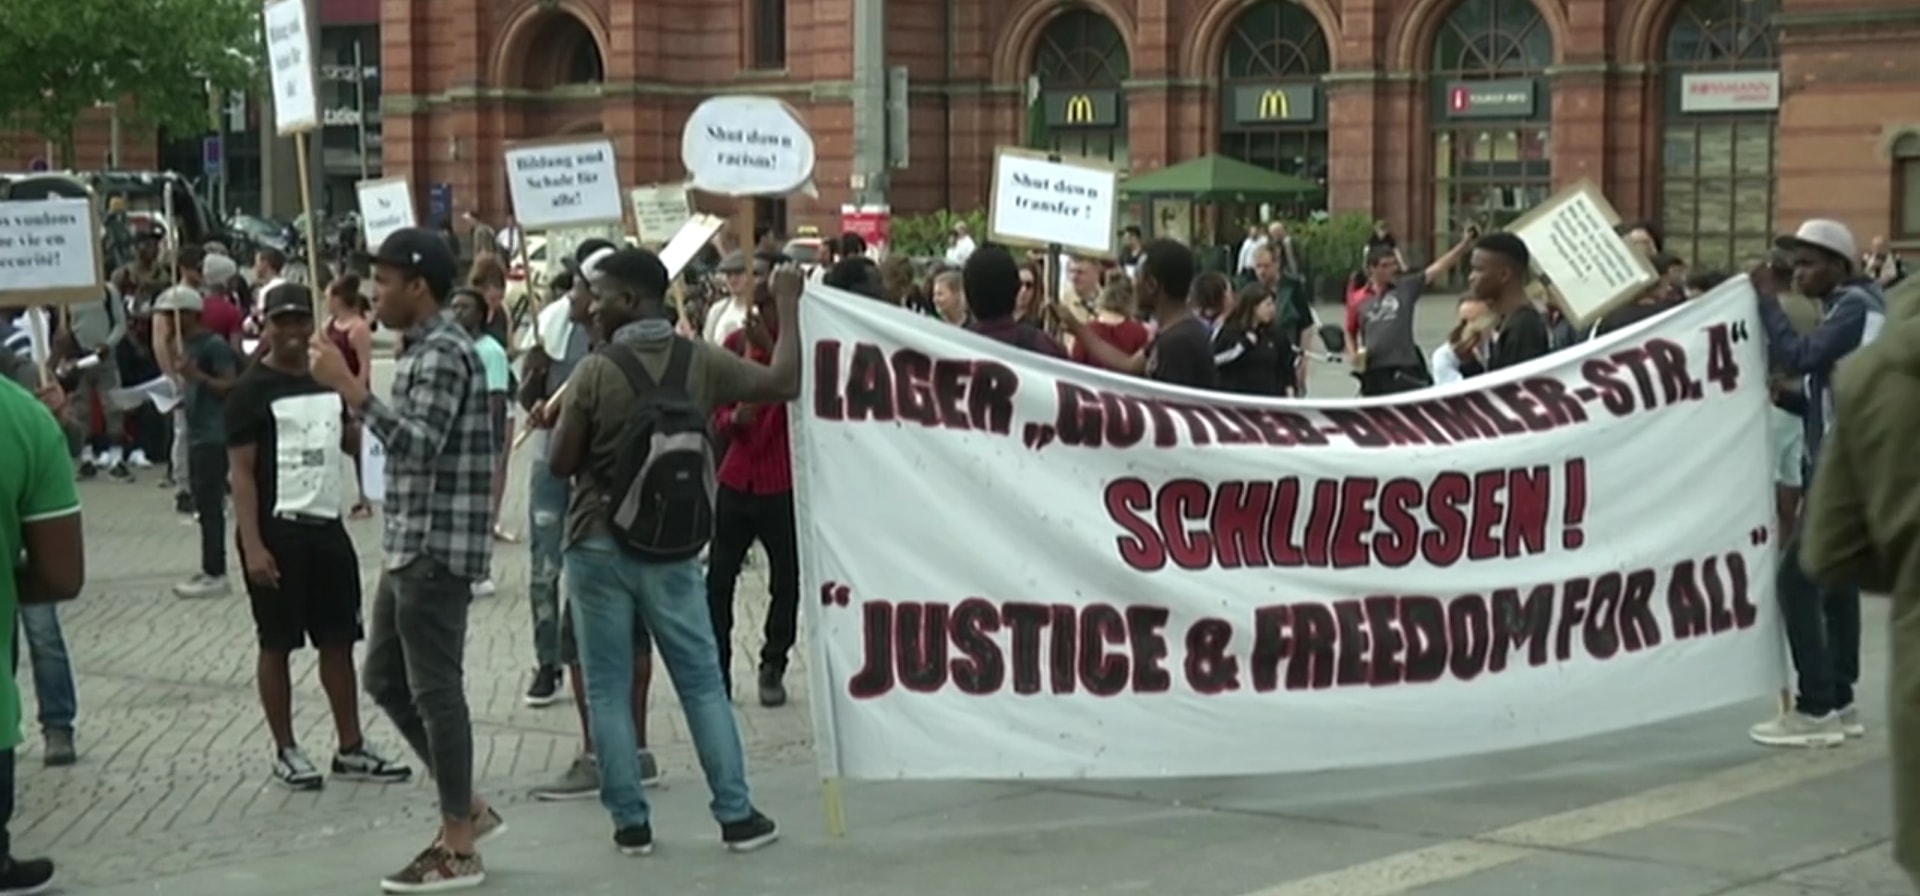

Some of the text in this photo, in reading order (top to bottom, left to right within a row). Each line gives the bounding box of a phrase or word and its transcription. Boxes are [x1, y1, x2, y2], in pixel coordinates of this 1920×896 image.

[1012, 172, 1098, 199] Shut down
[814, 339, 1018, 436] LAGER
[1184, 618, 1240, 692] &
[1250, 583, 1555, 693] FREEDOM
[1556, 568, 1661, 660] FOR
